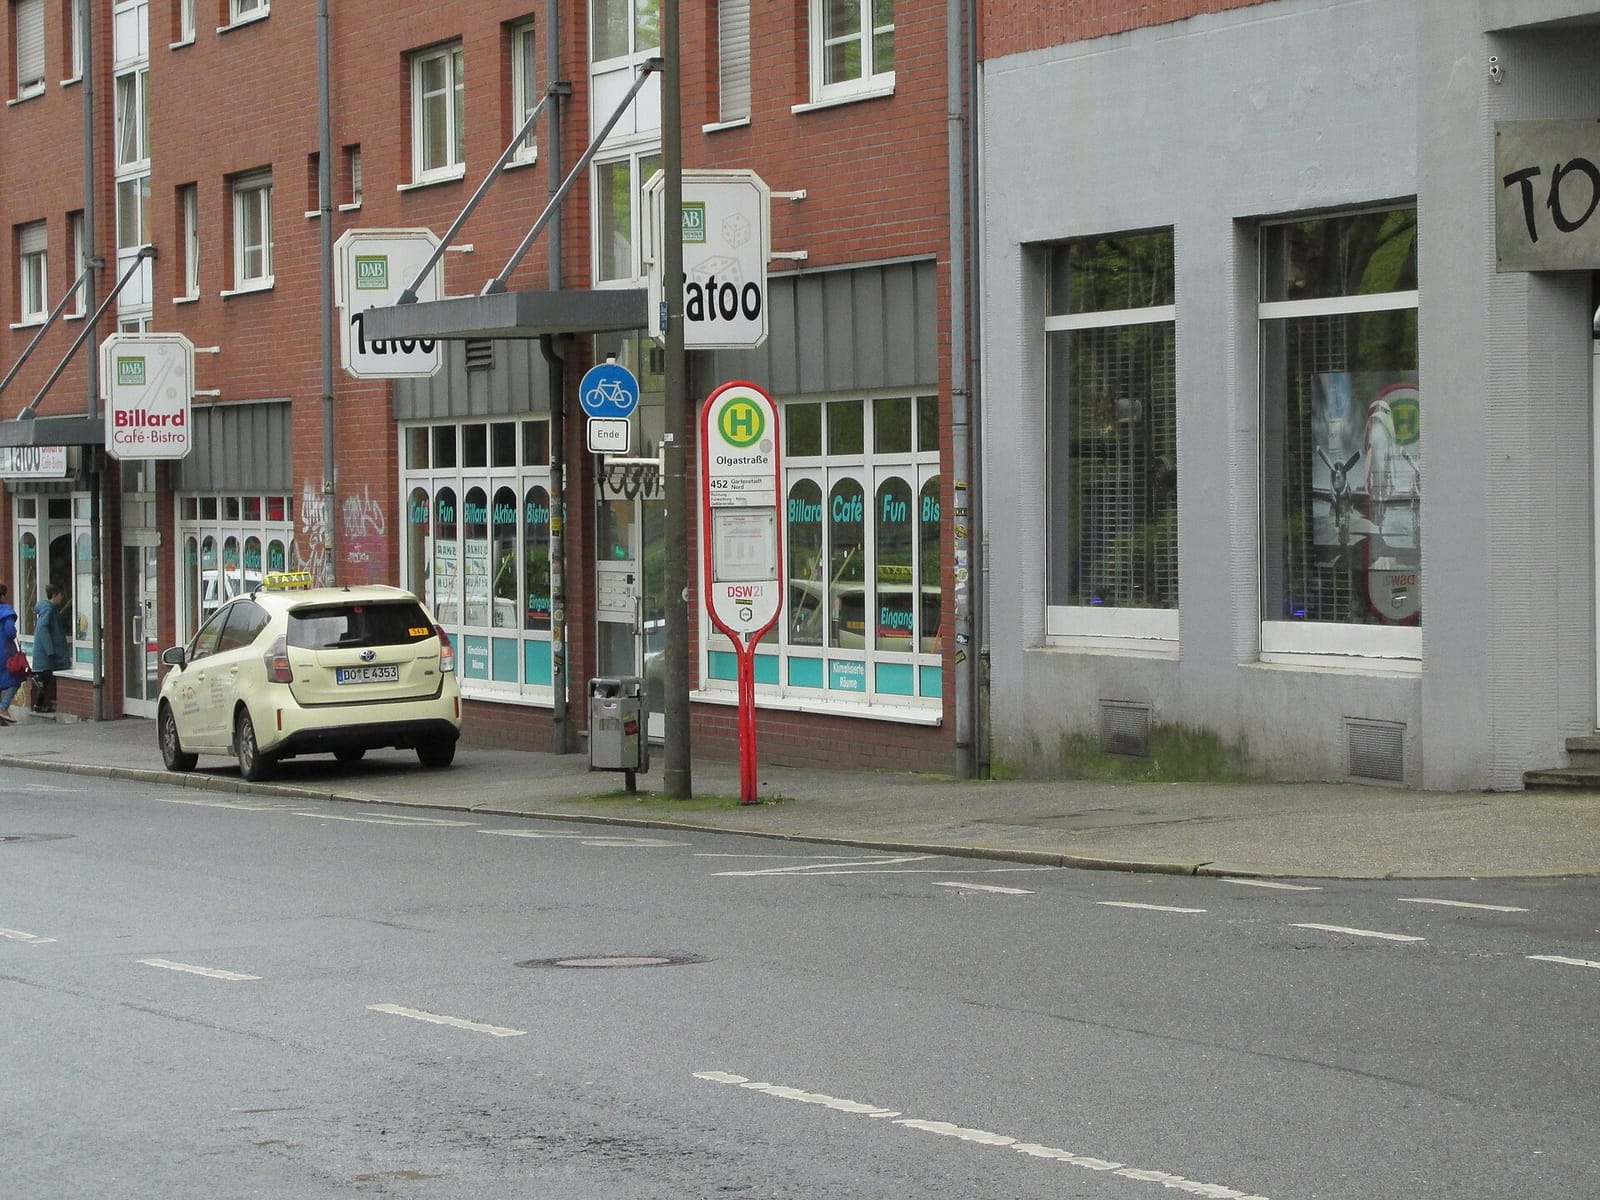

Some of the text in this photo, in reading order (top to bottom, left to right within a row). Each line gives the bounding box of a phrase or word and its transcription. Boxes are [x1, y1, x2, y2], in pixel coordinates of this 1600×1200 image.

[682, 211, 700, 228] AB
[360, 262, 383, 277] DAB
[663, 272, 761, 321] atoo
[122, 363, 142, 376] DAB
[114, 408, 185, 428] Billard
[730, 408, 753, 437] H
[597, 429, 620, 439] Ende
[716, 455, 769, 467] Olgastraße
[710, 479, 728, 489] 452
[438, 500, 453, 523] Fun
[526, 502, 549, 524] Bistro
[832, 494, 862, 523] Café
[882, 494, 906, 522] Fun
[922, 496, 941, 522] Bis
[273, 574, 306, 584] TAXI
[727, 585, 763, 598] DSW21
[881, 607, 913, 630] Eingang
[343, 666, 397, 680] DO E 4353
